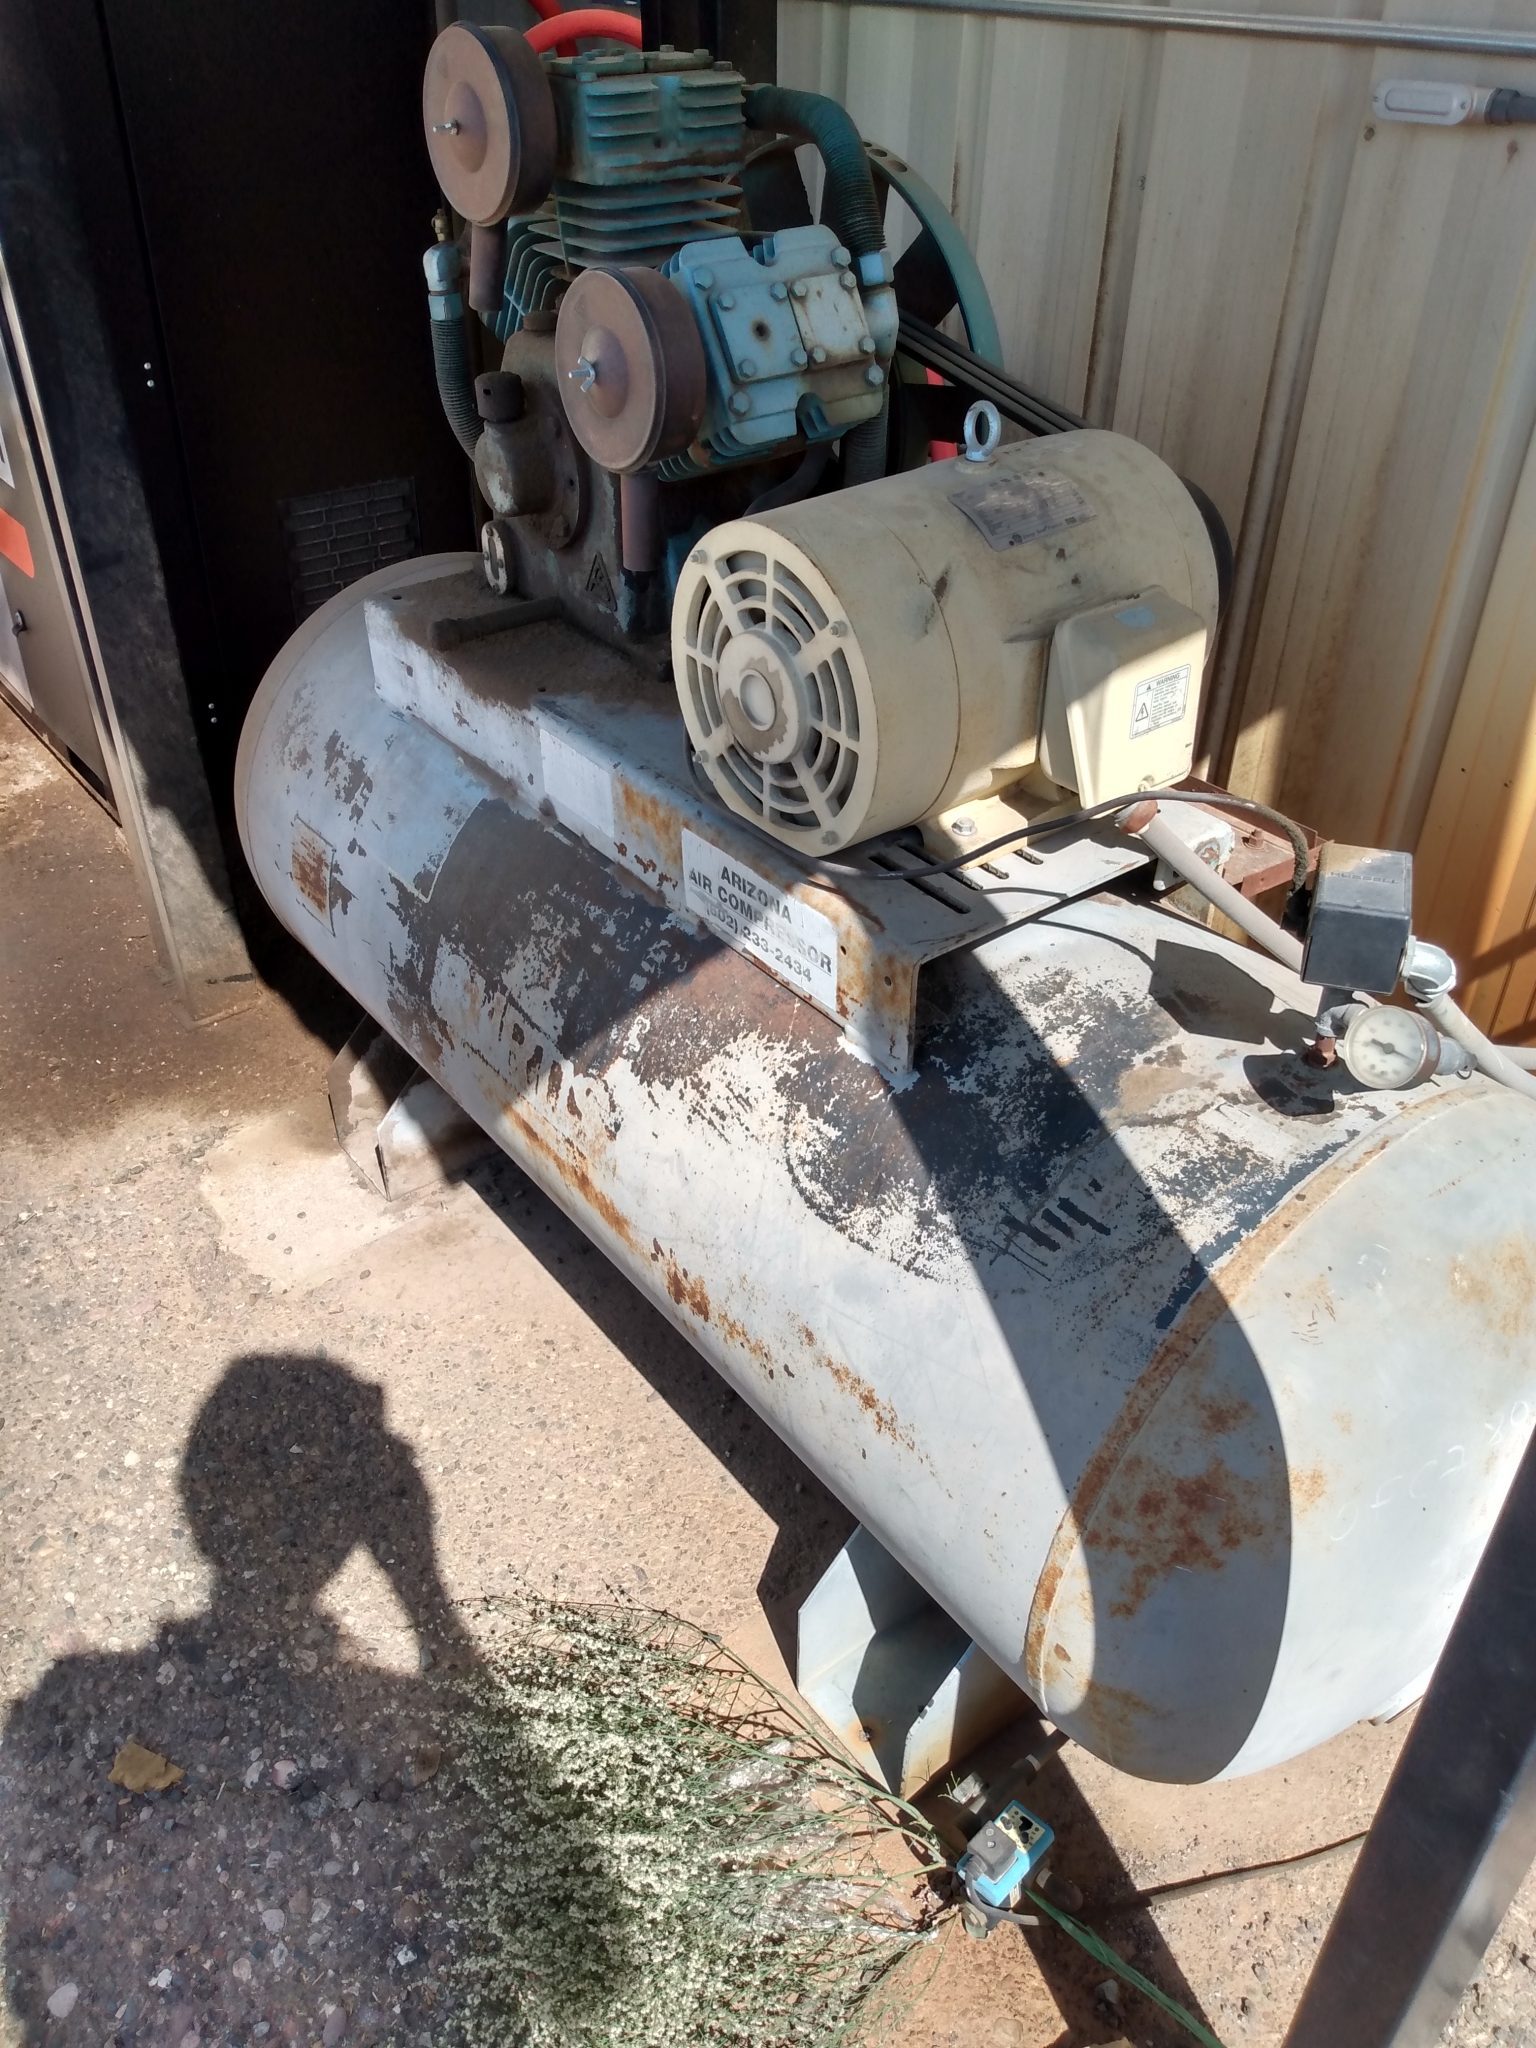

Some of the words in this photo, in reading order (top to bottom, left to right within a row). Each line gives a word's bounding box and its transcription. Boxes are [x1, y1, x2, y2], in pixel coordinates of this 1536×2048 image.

[1156, 673, 1180, 686] WARNING
[689, 868, 712, 894] AIR
[721, 866, 791, 923] ARIZONA
[742, 926, 811, 982] 233-2434
